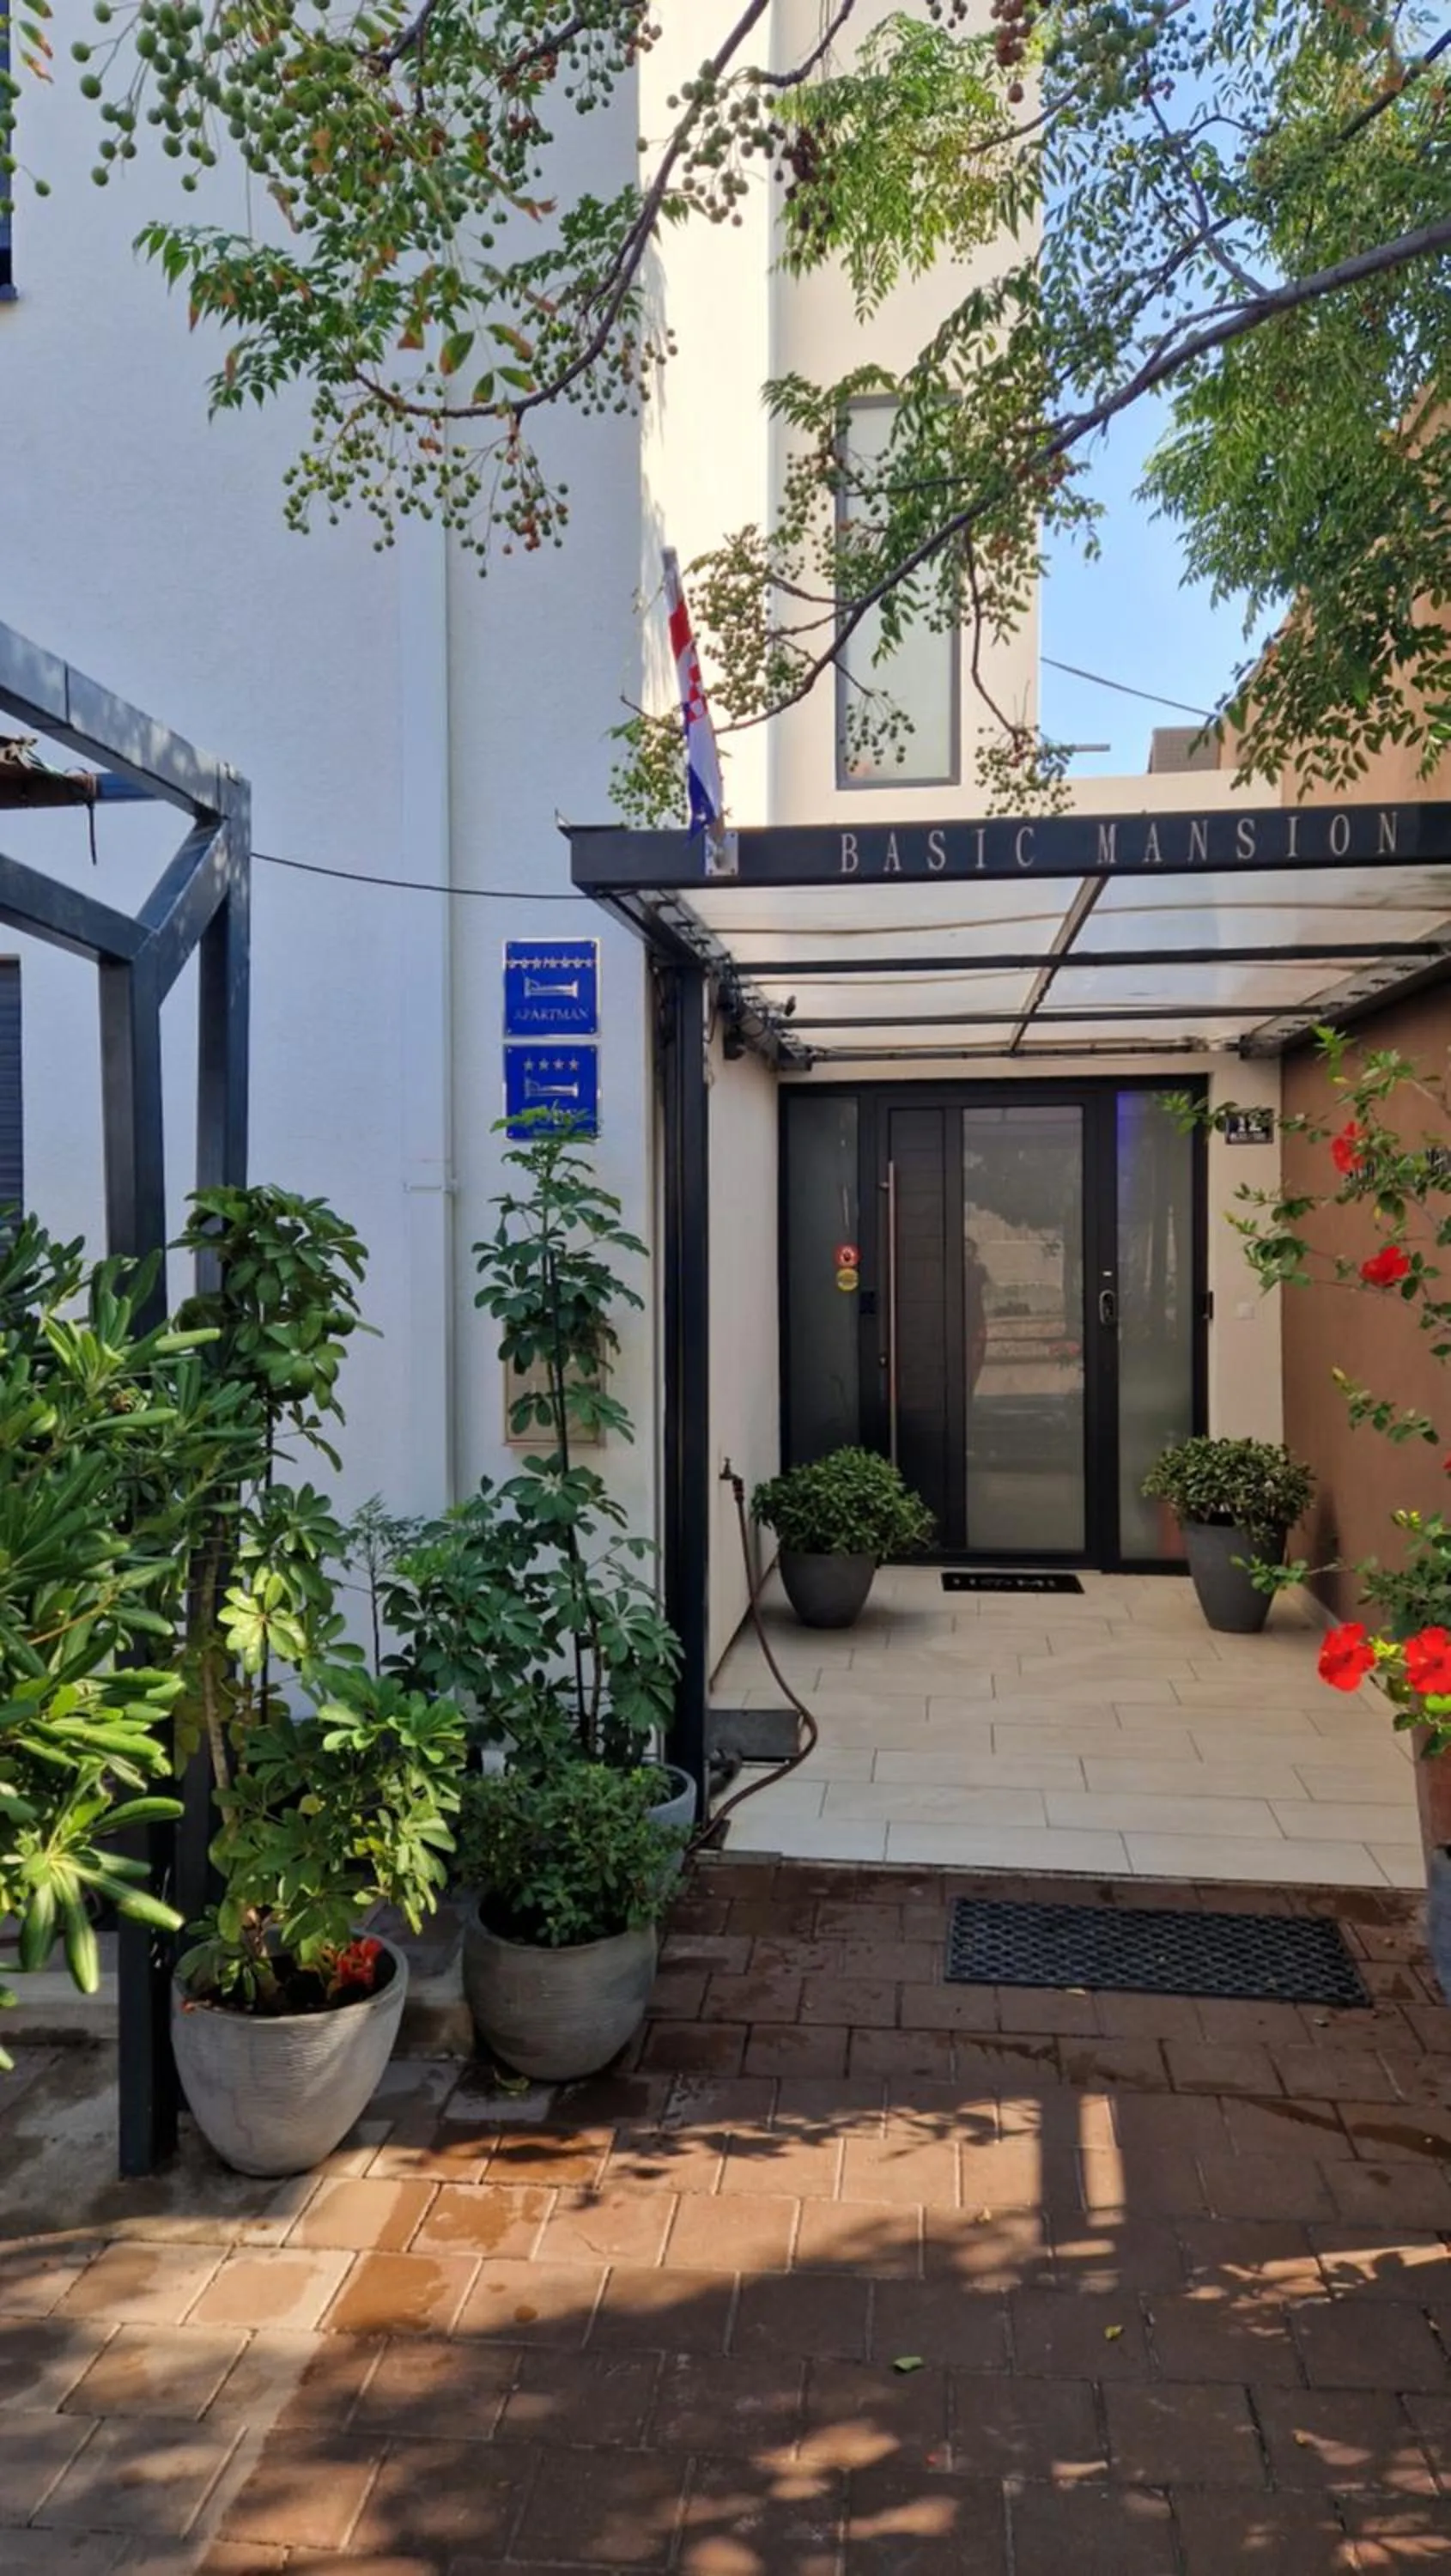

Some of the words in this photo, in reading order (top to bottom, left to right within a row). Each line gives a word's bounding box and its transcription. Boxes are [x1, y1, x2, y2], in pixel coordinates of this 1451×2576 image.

[841, 827, 1035, 873] BASIC
[1097, 812, 1398, 863] MANSION
[513, 1007, 590, 1021] APARTMAN
